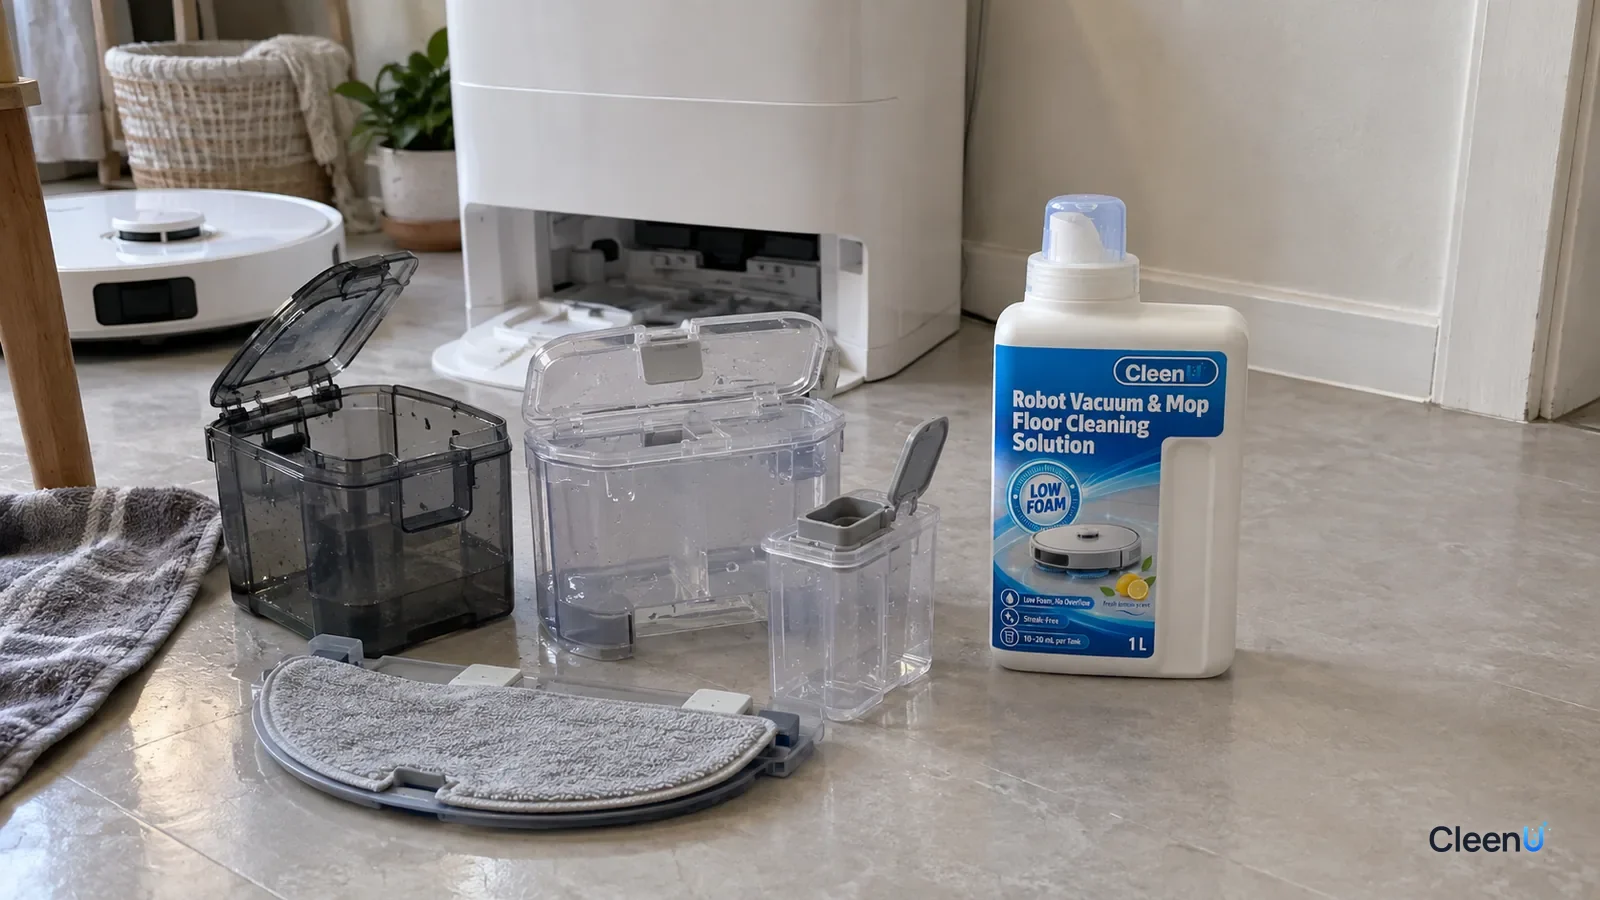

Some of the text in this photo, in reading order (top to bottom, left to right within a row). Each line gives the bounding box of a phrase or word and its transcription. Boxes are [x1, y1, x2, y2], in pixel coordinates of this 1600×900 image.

[1012, 390, 1209, 417] Robot Vacuum & Mop
[1012, 412, 1150, 438] Floor Cleaning
[1012, 432, 1095, 454] Solution
[1030, 482, 1062, 499] LOW
[1026, 496, 1066, 515] FOAM
[1024, 596, 1035, 604] Low
[1129, 636, 1147, 651] 1 L
